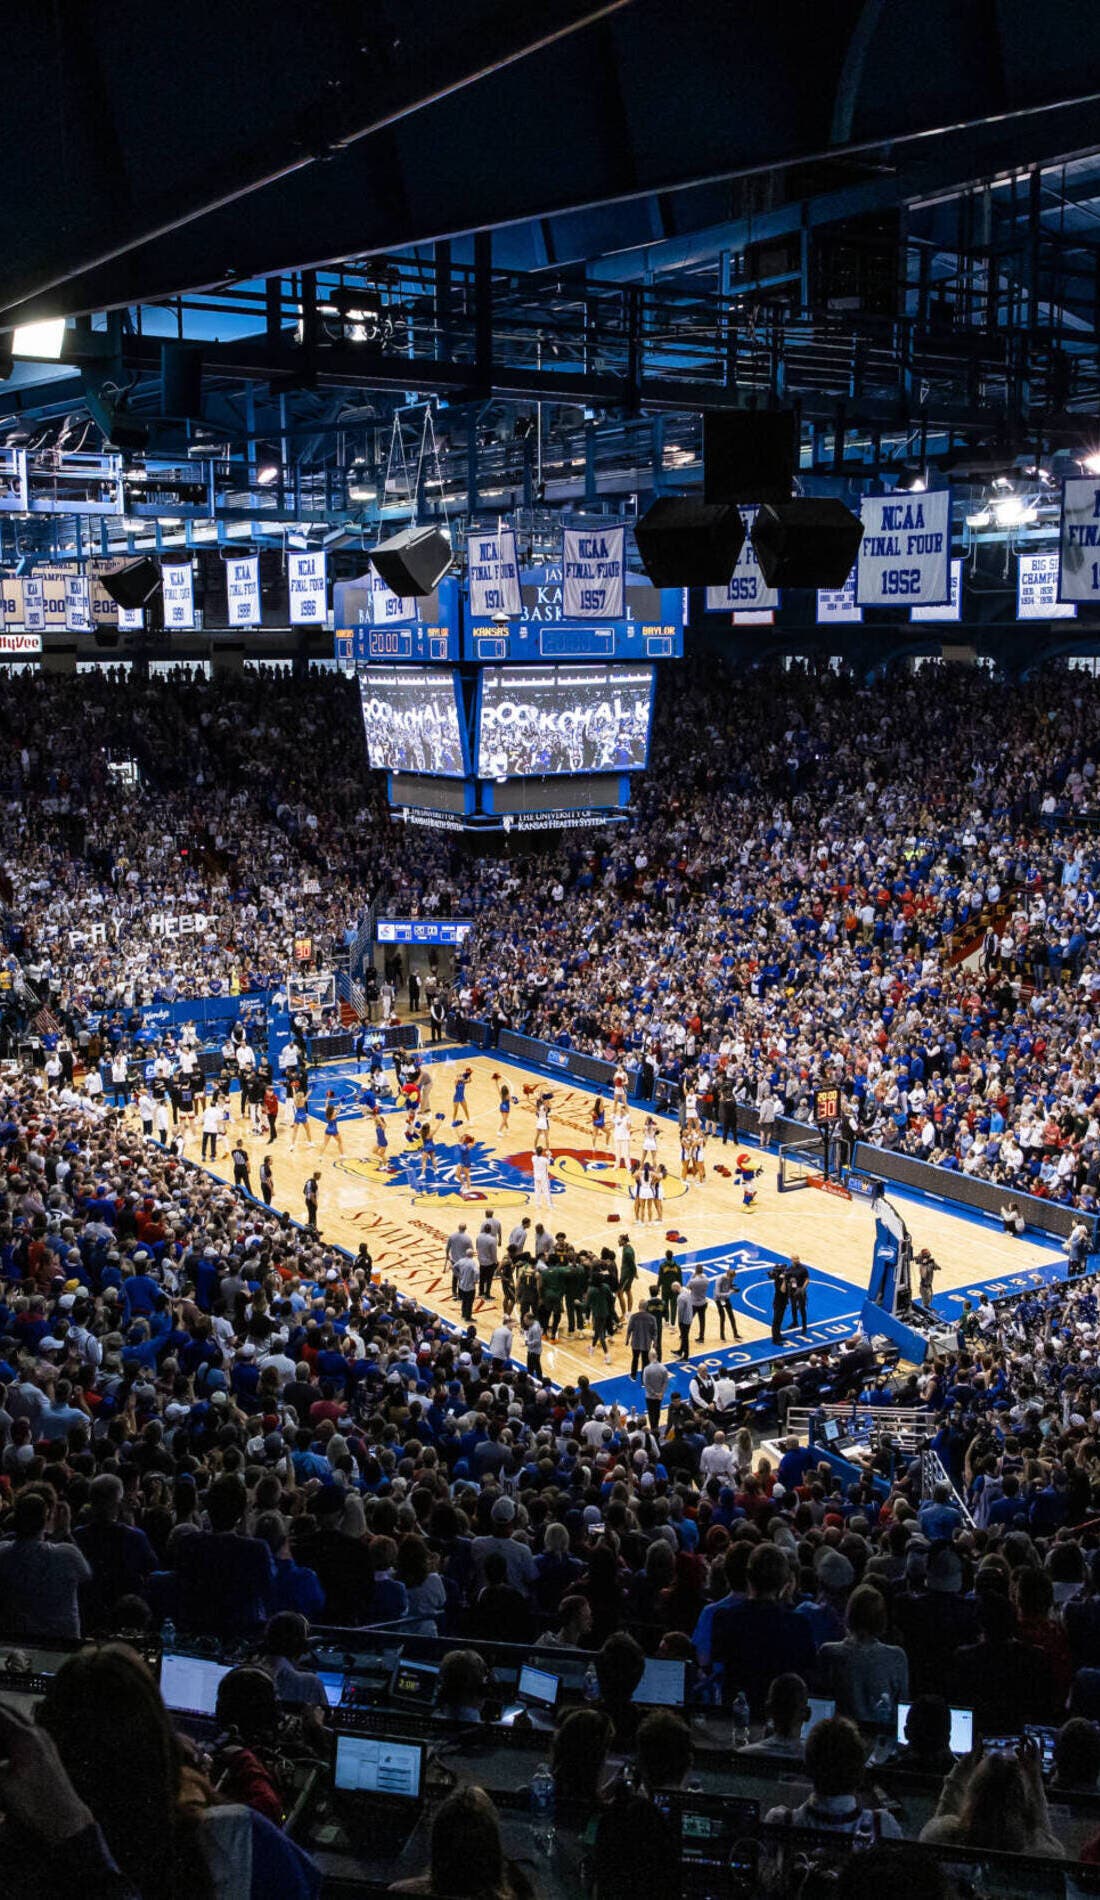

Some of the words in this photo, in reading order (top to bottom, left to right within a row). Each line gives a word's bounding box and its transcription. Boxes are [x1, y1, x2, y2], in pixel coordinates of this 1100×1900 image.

[881, 503, 925, 531] NCAA
[579, 538, 609, 559] NCAA
[863, 536, 900, 557] FINAL
[907, 533, 943, 554] FOUR
[298, 558, 316, 576] NCAA
[471, 565, 493, 581] FINAL
[566, 562, 595, 578] FINAL
[598, 561, 620, 577] FOUR
[1031, 559, 1047, 571] BIG
[545, 568, 563, 583] JAY
[881, 569, 921, 594] 1952
[727, 577, 757, 600] 1953
[385, 598, 403, 616] 1974
[580, 589, 606, 610] 1957
[473, 628, 509, 637] KANSAS
[642, 626, 675, 636] BAYLOR
[518, 819, 548, 832] KANSAS
[548, 818, 578, 830] HEALTH
[579, 816, 607, 828] SYSTEM
[519, 813, 534, 822] THE
[536, 811, 580, 820] UNIVERSITY
[582, 810, 592, 818] OF
[69, 917, 125, 950] PAY
[819, 1101, 838, 1119] 30
